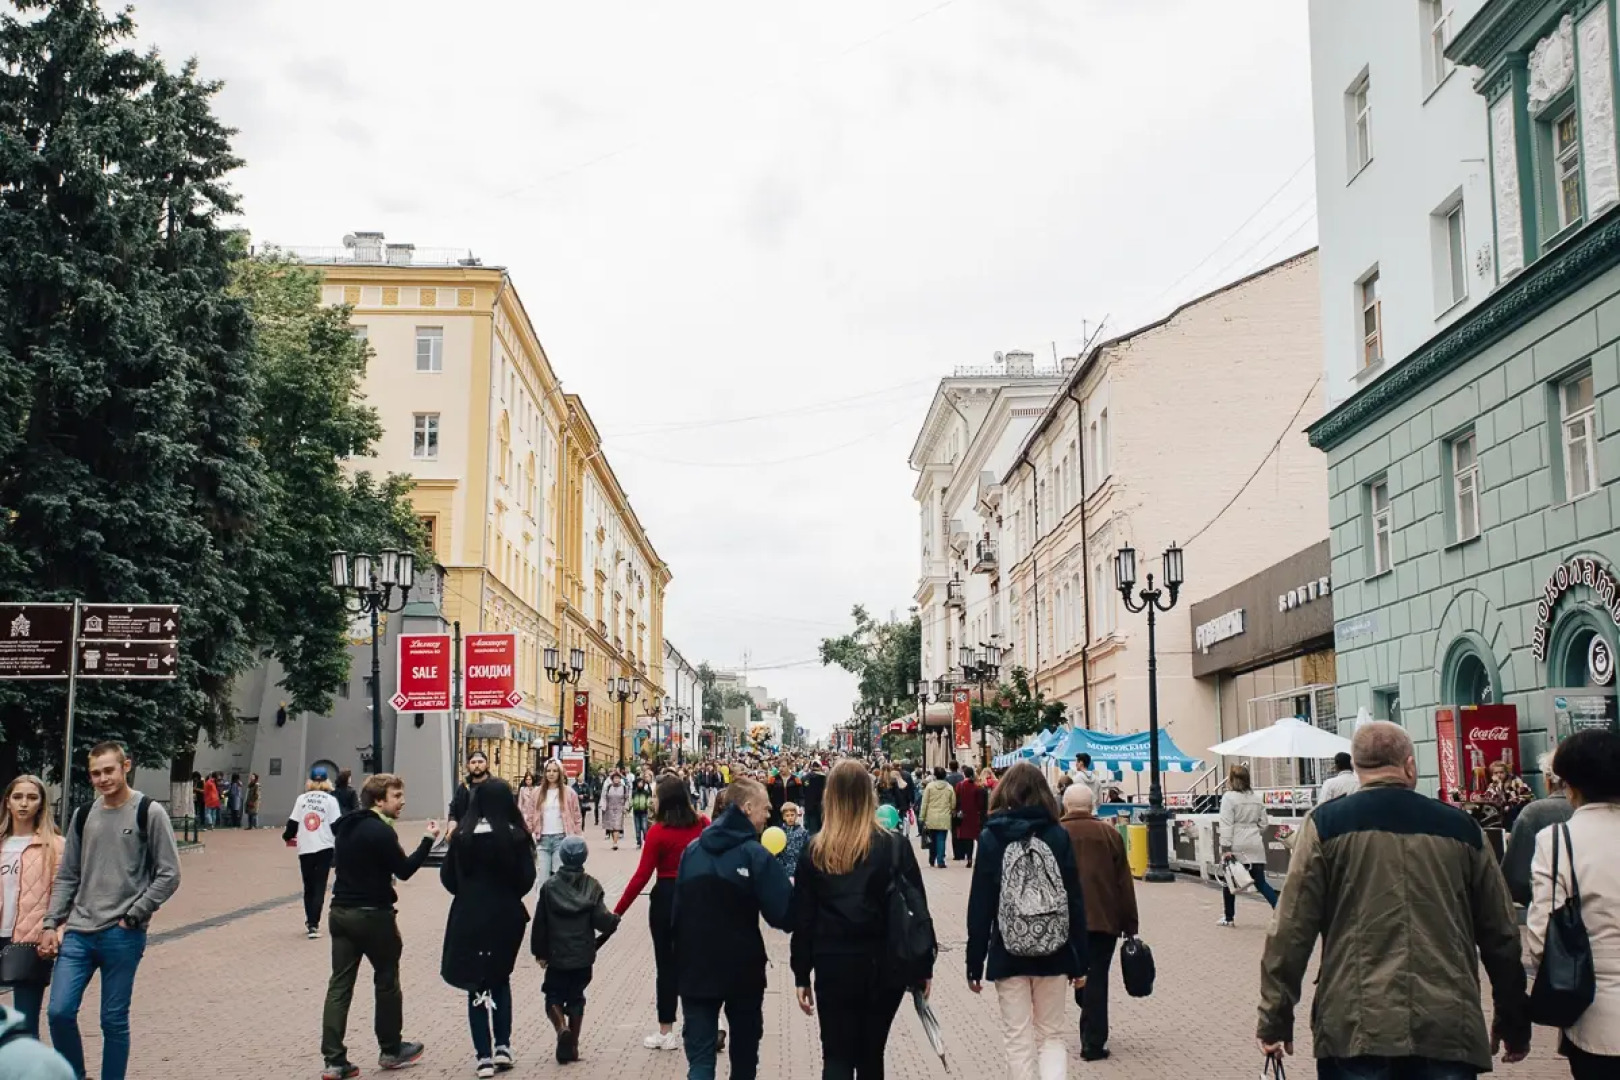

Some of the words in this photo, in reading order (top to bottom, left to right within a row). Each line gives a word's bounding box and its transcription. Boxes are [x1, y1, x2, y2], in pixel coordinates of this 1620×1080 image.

[412, 666, 438, 679] SALE
[469, 664, 511, 679] СКИДКИ
[1469, 726, 1510, 741] Coca-Cola
[1086, 742, 1151, 751] МОРОЖЕНО
